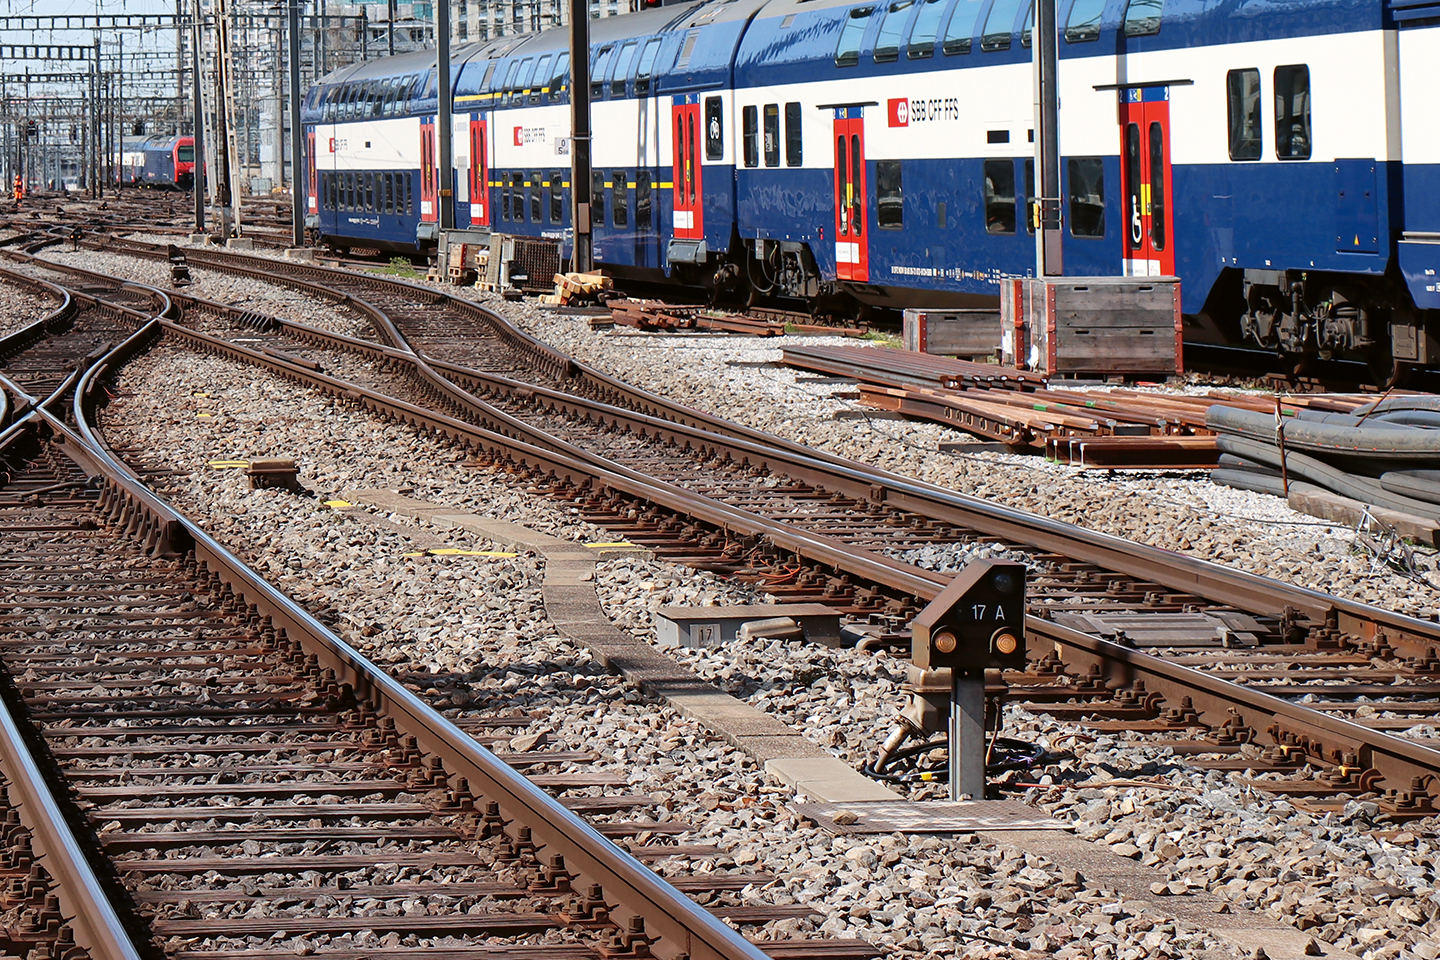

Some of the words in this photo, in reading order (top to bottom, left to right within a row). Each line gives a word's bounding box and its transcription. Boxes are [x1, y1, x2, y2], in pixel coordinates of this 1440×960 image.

[1164, 86, 1170, 101] 2
[911, 100, 926, 122] SBB
[928, 99, 942, 121] CFF
[944, 97, 959, 120] FFS
[561, 139, 566, 147] 0
[971, 604, 987, 620] 17
[995, 604, 1006, 621] A
[699, 628, 713, 641] 17
